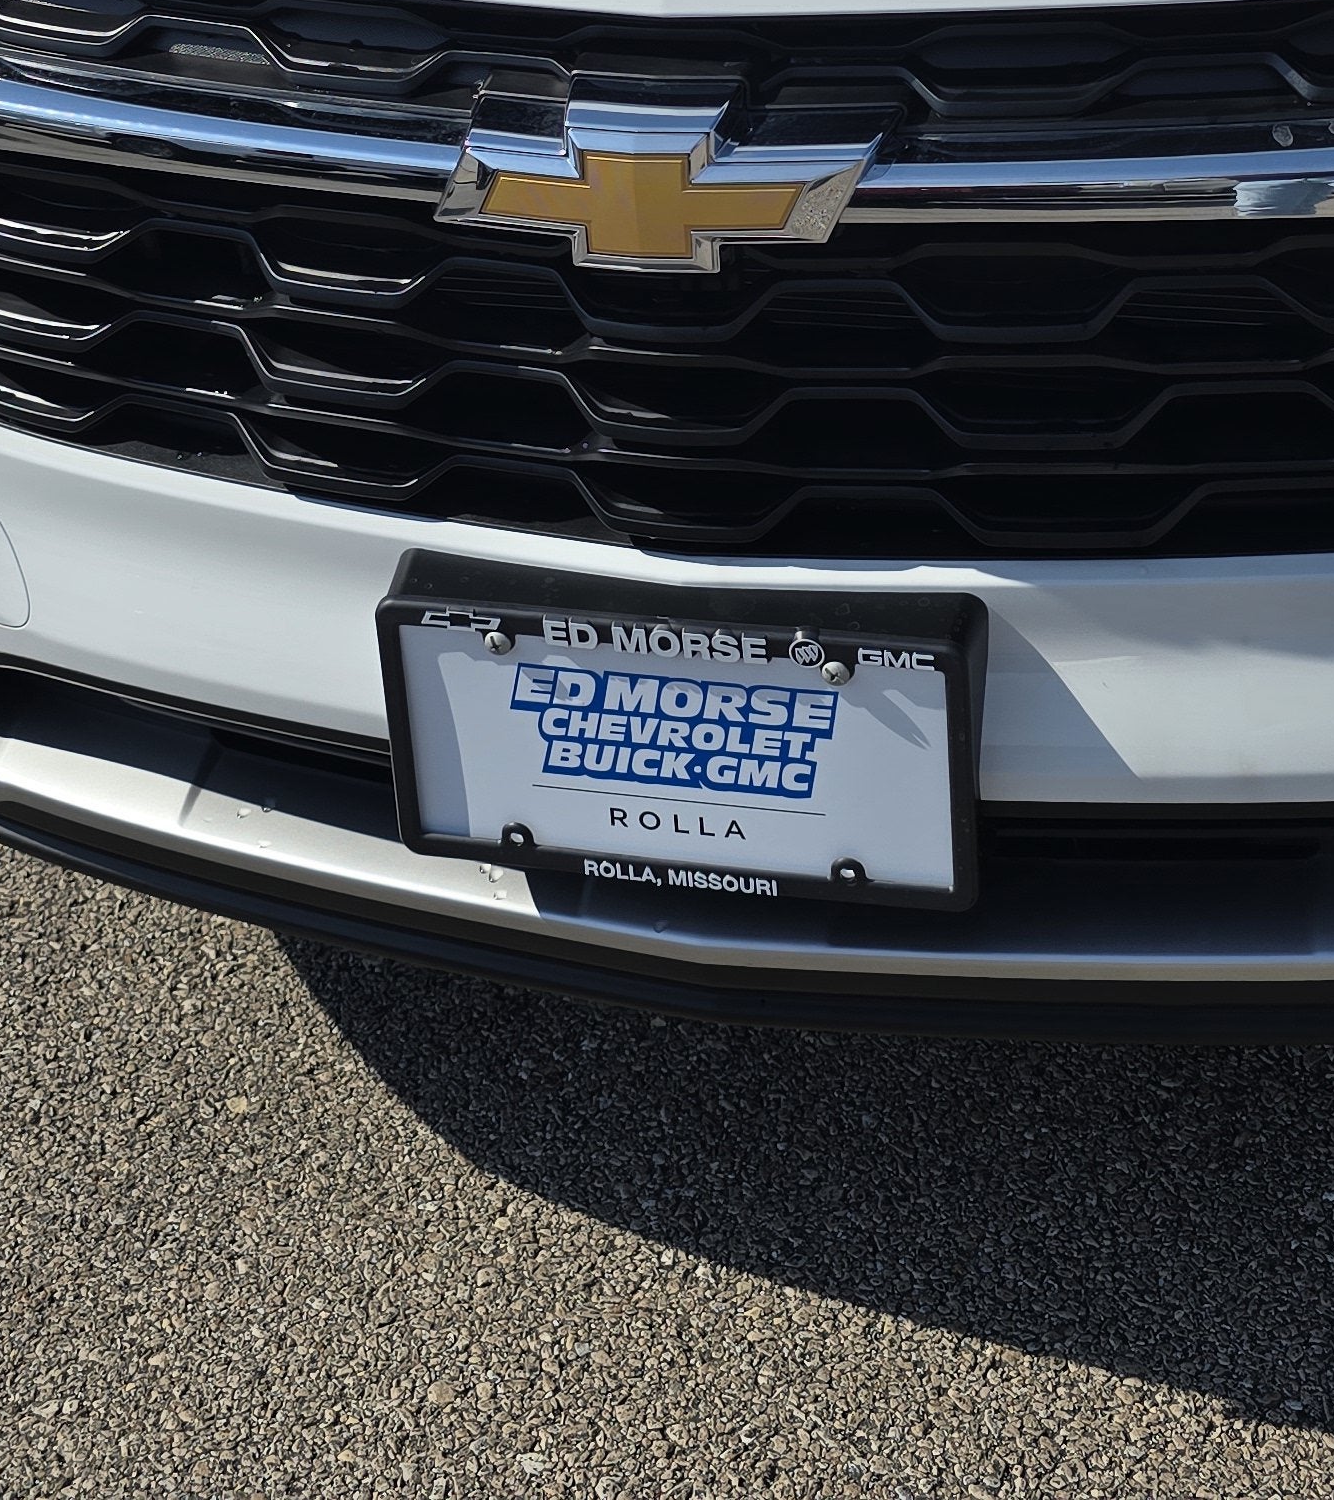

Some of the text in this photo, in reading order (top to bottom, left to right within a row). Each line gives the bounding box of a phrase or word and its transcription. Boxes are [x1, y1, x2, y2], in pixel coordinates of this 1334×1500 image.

[543, 614, 767, 664] ED MORSE
[857, 647, 935, 671] GMC
[514, 666, 834, 730] ED MORSE
[541, 708, 812, 758] CHEVROLET
[609, 807, 746, 840] ROLLA
[583, 858, 779, 897] ROLLA, MISSOURI
